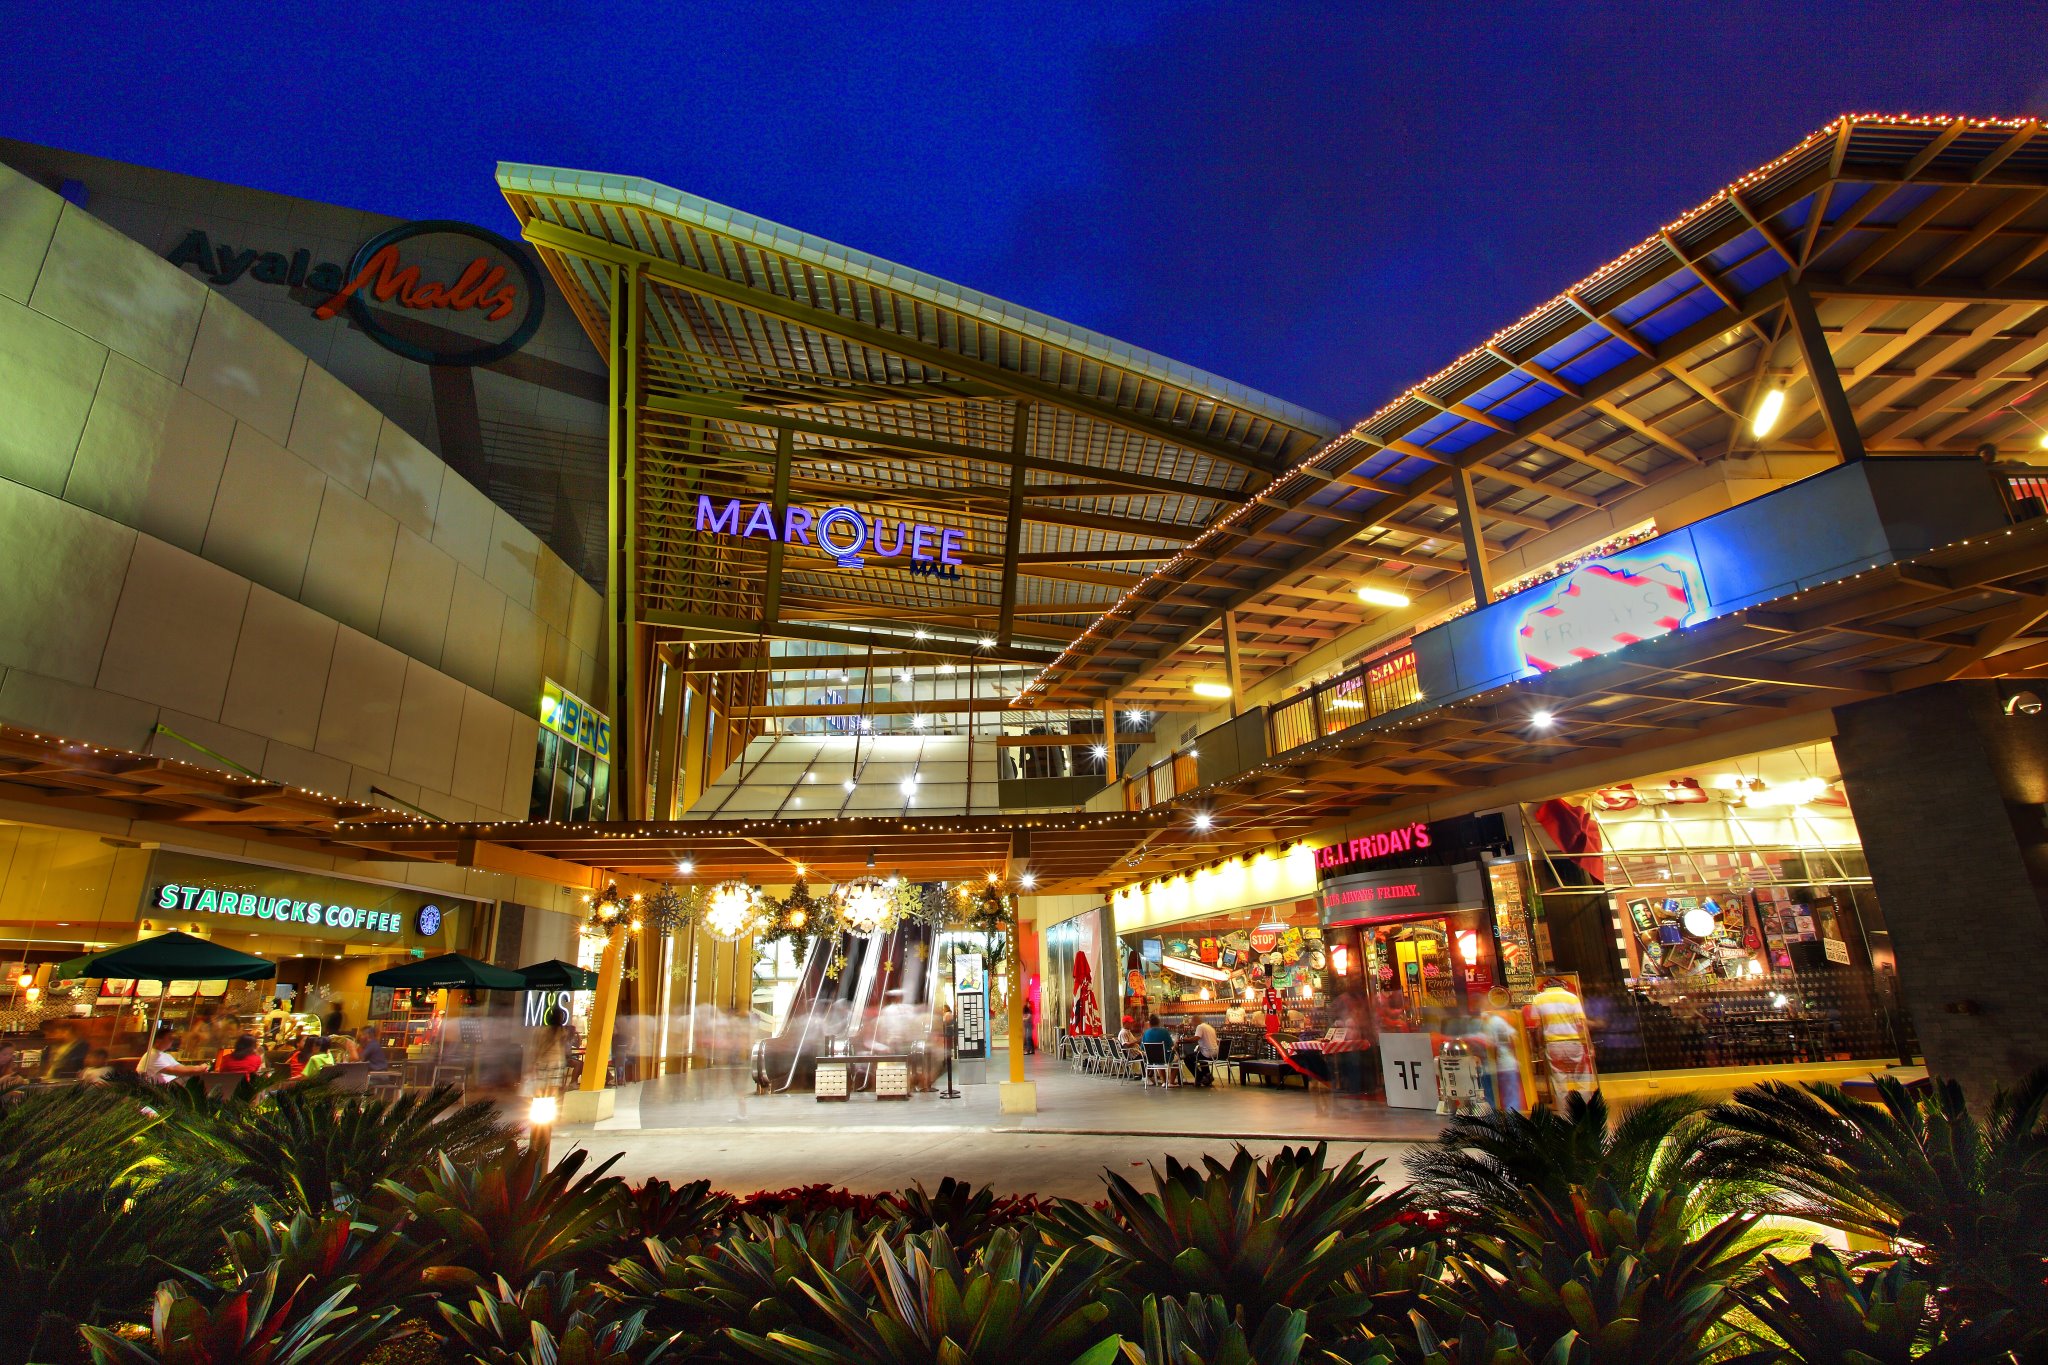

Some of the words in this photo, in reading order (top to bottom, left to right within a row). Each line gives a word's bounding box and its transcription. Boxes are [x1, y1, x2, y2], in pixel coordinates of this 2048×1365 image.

[166, 229, 346, 290] Ayala
[315, 244, 517, 322] Malls
[696, 494, 965, 569] MARQUEE
[909, 559, 961, 582] MALL
[158, 884, 322, 924] STARBUCKS
[325, 905, 401, 933] COFFEE
[1342, 888, 1374, 904] ALWAYS
[1377, 884, 1421, 901] FRIDAY.
[1251, 934, 1274, 945] STOP
[525, 990, 571, 1027] M&S
